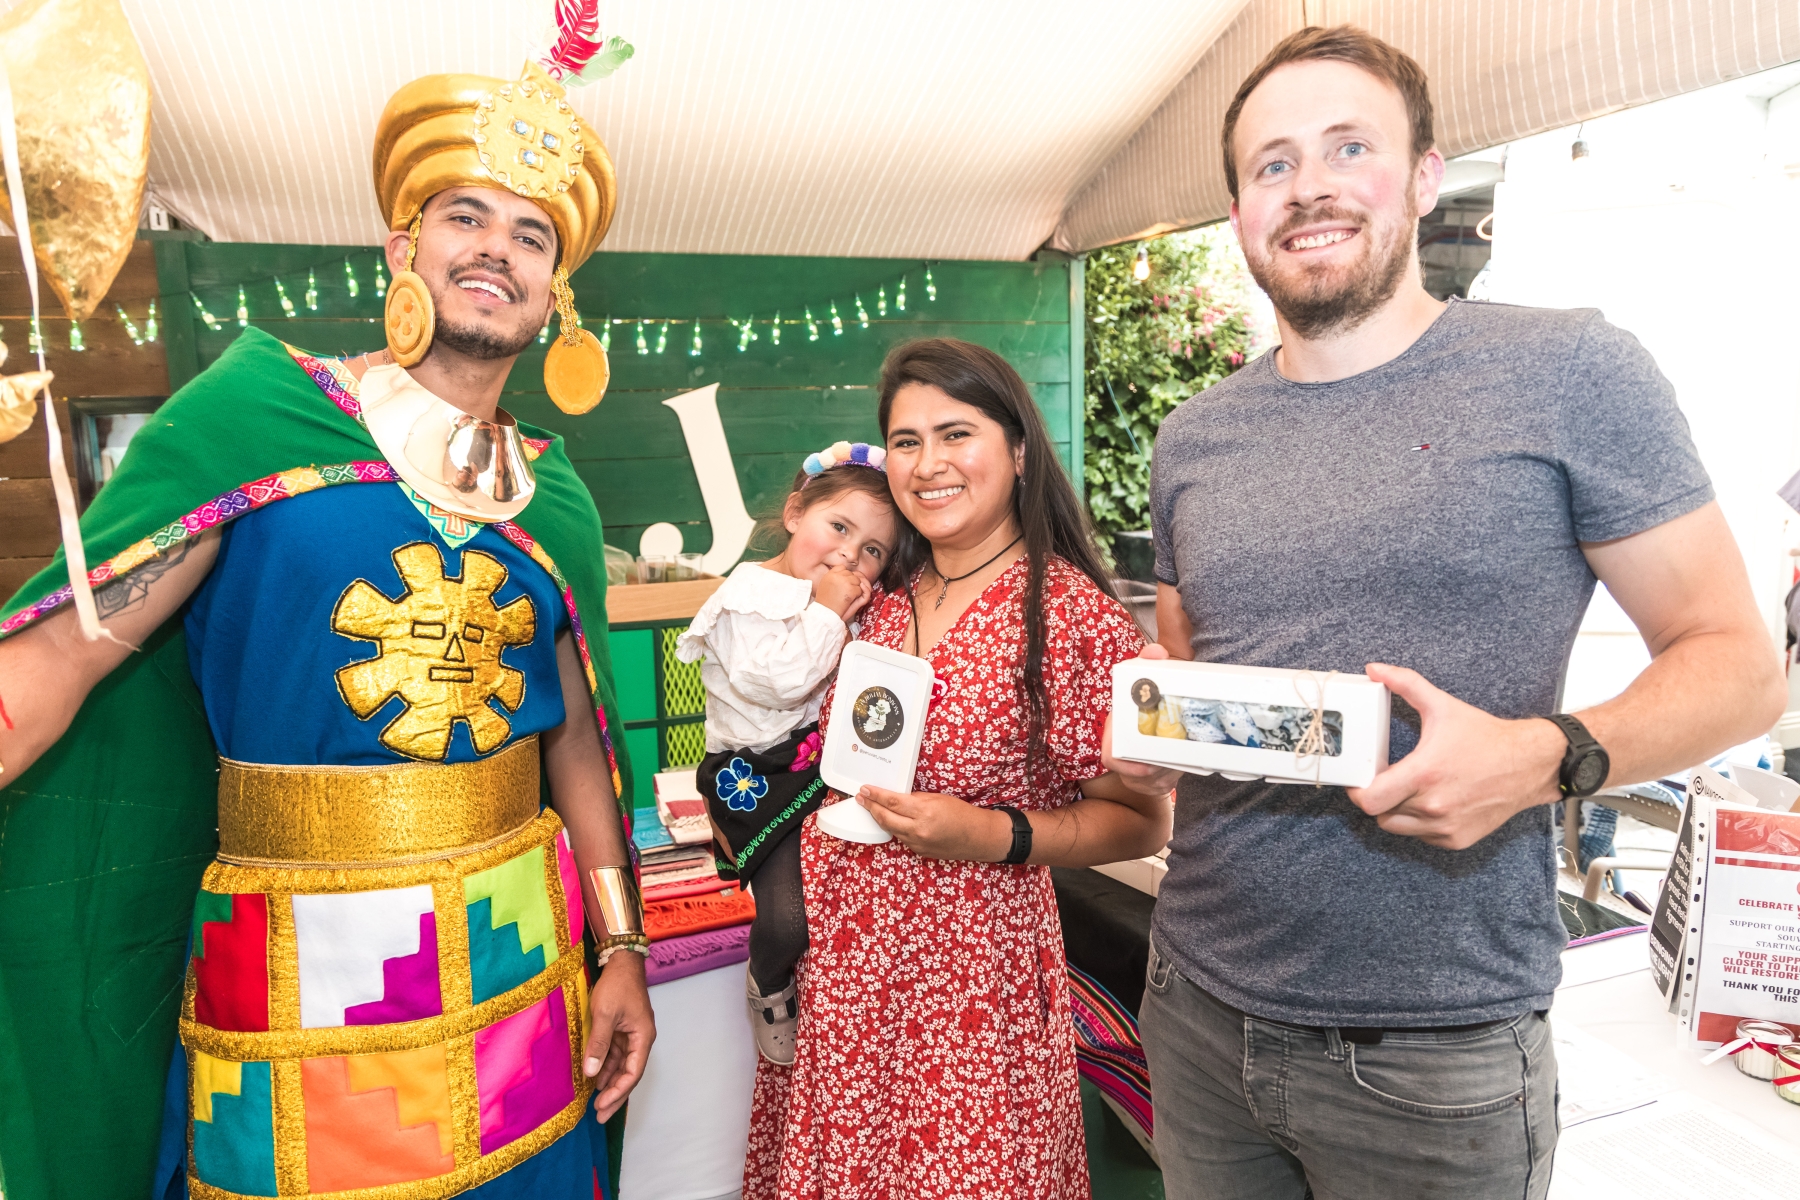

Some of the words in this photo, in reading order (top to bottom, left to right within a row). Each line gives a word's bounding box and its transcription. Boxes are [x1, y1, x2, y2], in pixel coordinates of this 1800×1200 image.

[640, 382, 757, 577] J
[1738, 898, 1794, 911] CELEBRATE
[1729, 919, 1773, 930] SUPPORT
[1774, 924, 1795, 933] OUR
[1738, 950, 1768, 961] YOUR
[1722, 956, 1764, 969] CLOSER
[1767, 961, 1781, 971] TO
[1784, 963, 1800, 973] TH
[1723, 964, 1748, 975] WILL
[1751, 968, 1800, 981] RESTORE
[1722, 979, 1759, 991] THANK
[1761, 984, 1784, 994] YOU
[1773, 993, 1799, 1004] THIS
